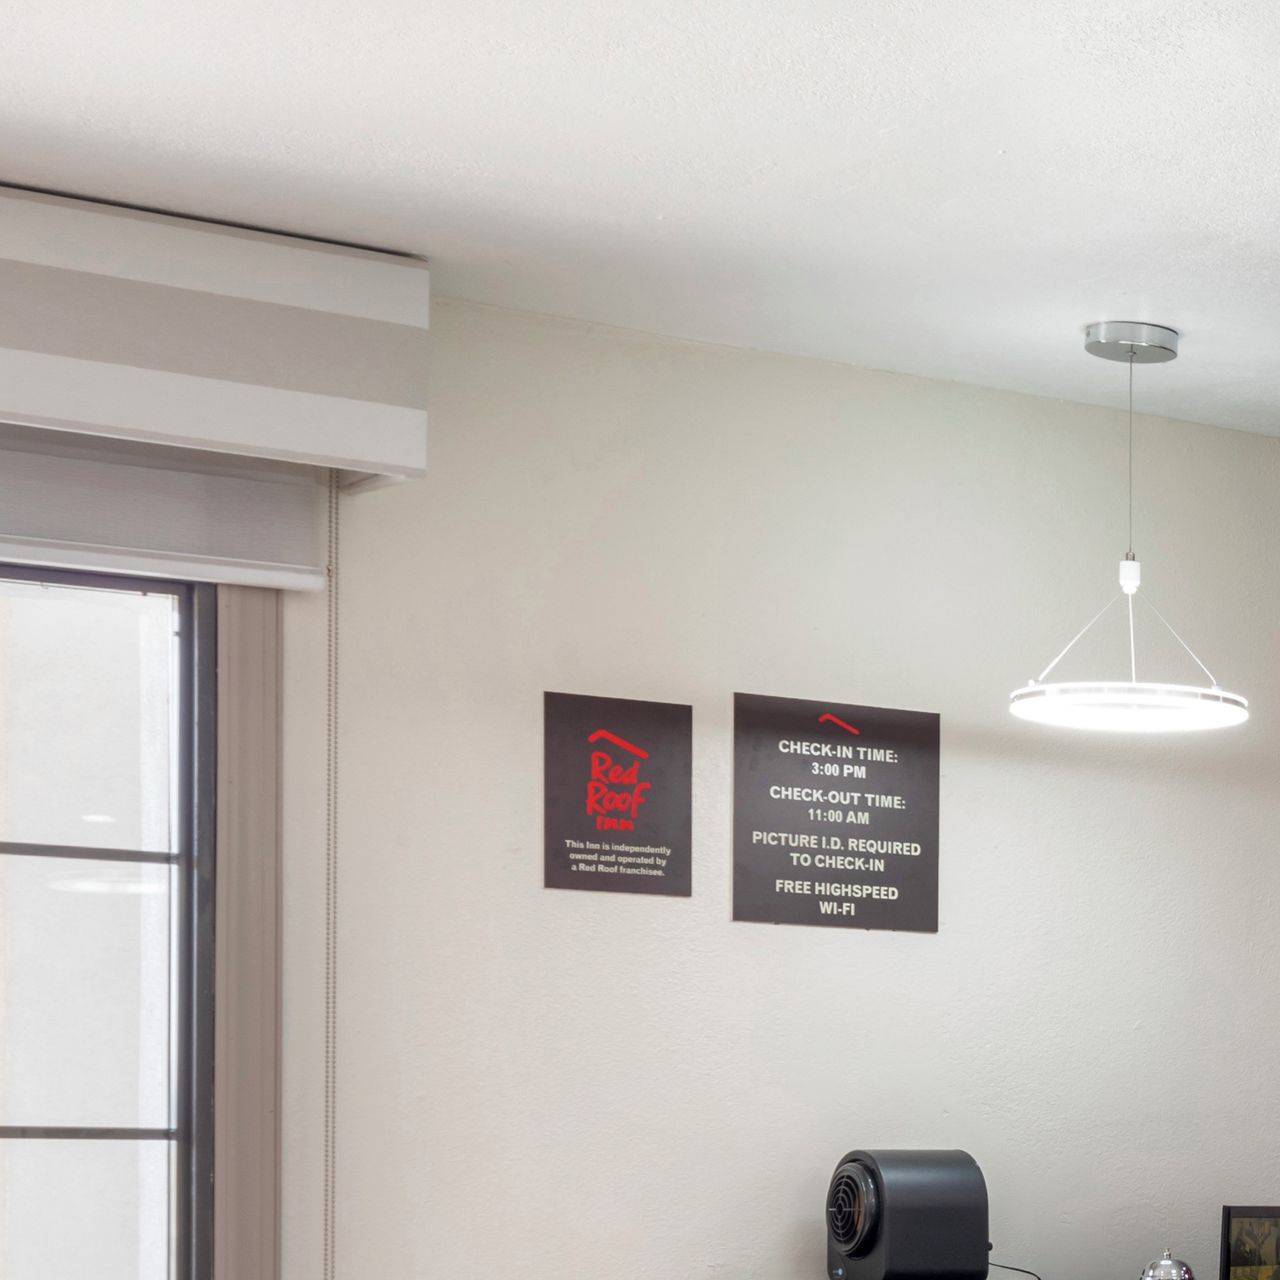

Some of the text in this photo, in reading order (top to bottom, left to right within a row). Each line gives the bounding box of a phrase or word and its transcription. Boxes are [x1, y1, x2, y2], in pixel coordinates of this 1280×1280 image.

[778, 740, 898, 763] CHECK-IN TIME:
[591, 752, 640, 784] Red
[812, 762, 866, 778] 3:00 PM
[586, 781, 651, 818] Roof
[770, 786, 906, 809] CHECK-OUT TIME:
[596, 816, 634, 832] Inn
[808, 808, 870, 825] 11:00 AM
[565, 840, 671, 855] This Inn is independently
[752, 831, 921, 856] PICTURE I.D. REQUIRED
[569, 853, 667, 866] owned and operated by
[790, 852, 885, 872] TO CHECK-IN
[579, 864, 596, 872] Red
[597, 864, 619, 873] Roof
[620, 866, 665, 877] franchisee.
[775, 879, 898, 900] FREE HIGHSPEED
[819, 901, 855, 916] WI-FI
